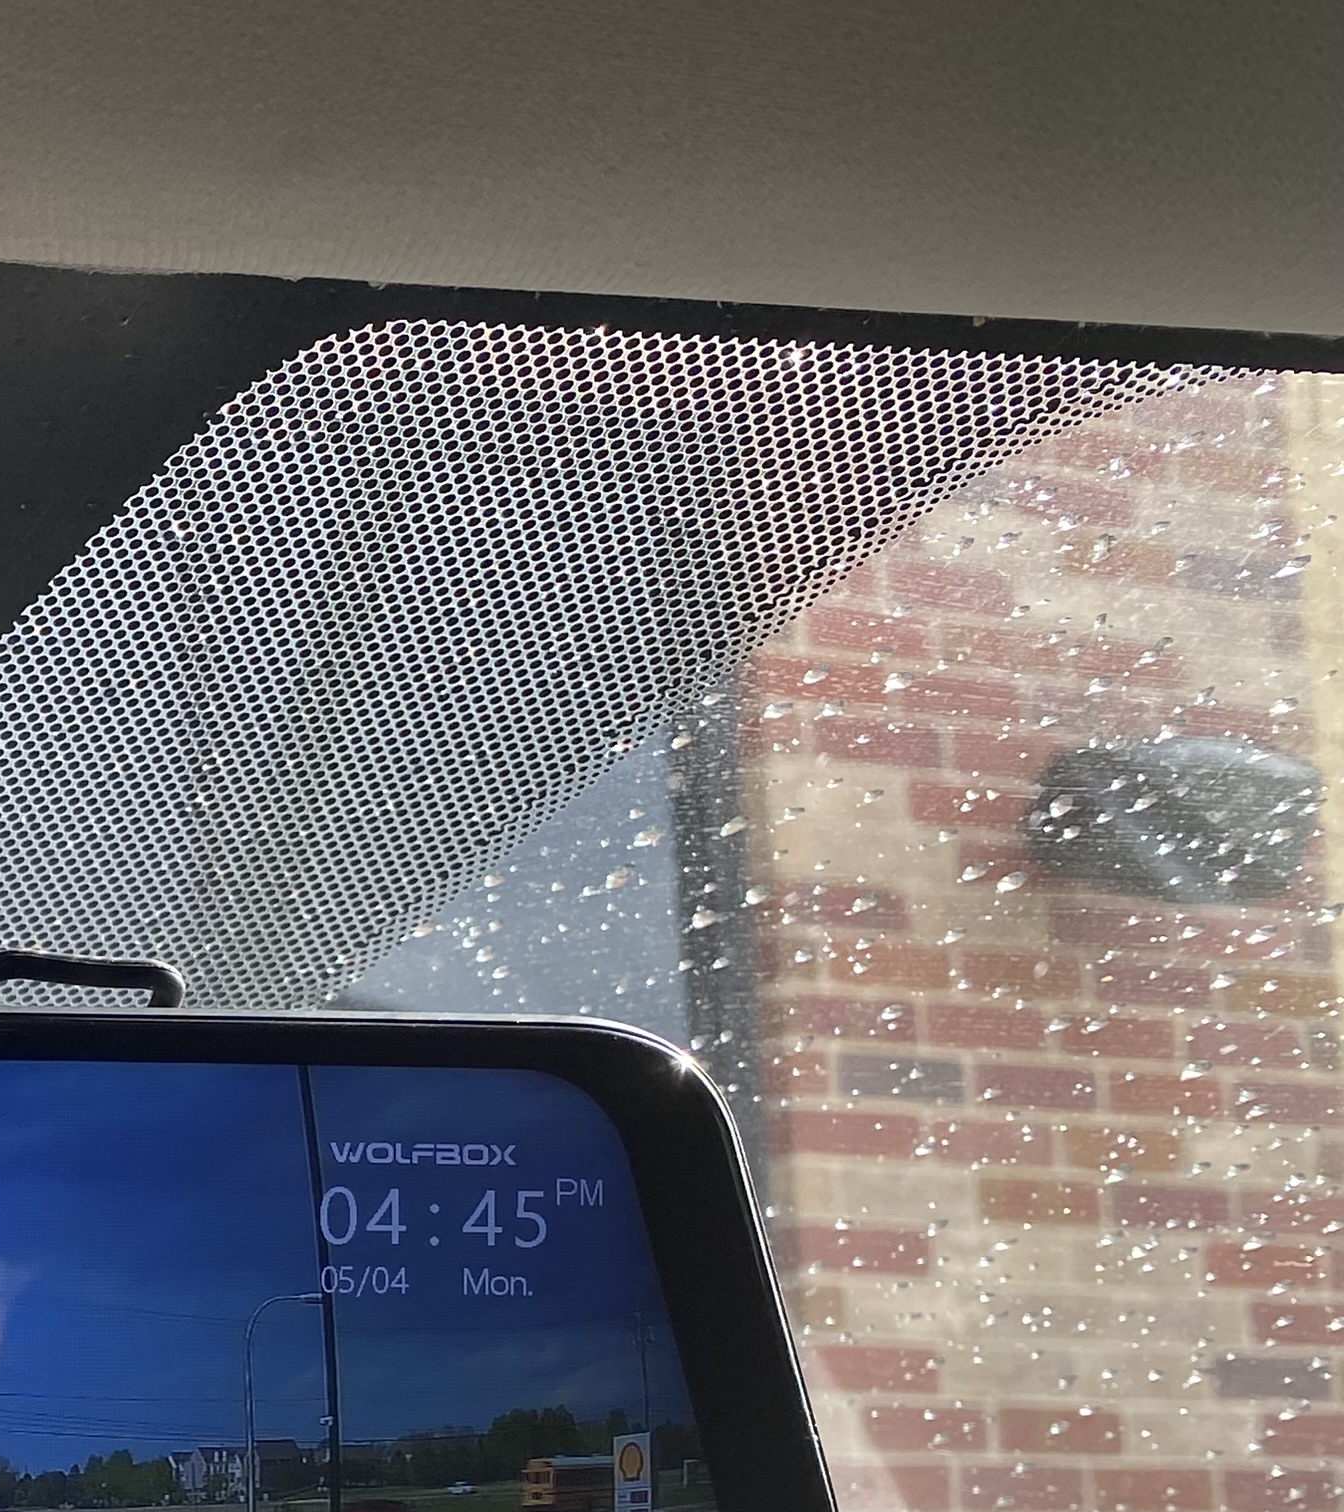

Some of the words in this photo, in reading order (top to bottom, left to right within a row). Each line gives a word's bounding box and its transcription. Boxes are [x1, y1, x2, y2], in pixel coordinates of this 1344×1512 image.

[330, 1141, 516, 1166] WOLFBOX
[555, 1178, 604, 1207] PM
[321, 1265, 409, 1298] 05/04
[462, 1267, 534, 1297] Mon.
